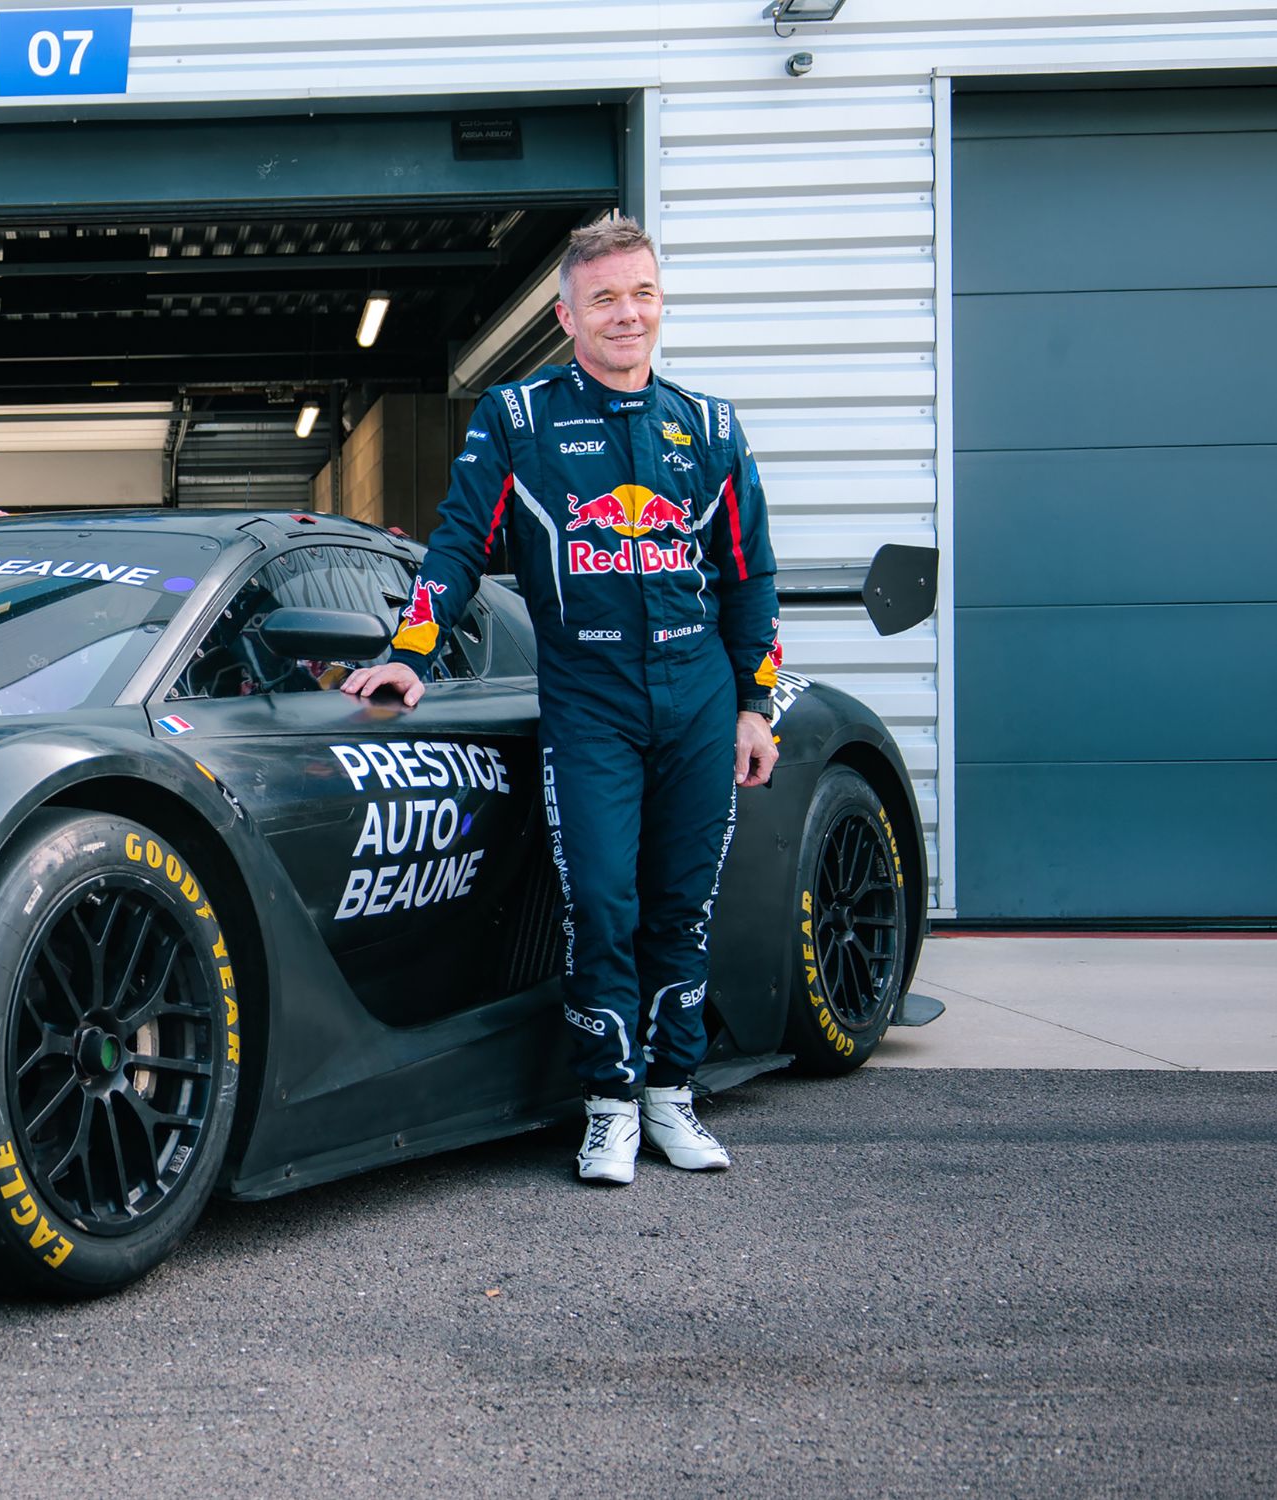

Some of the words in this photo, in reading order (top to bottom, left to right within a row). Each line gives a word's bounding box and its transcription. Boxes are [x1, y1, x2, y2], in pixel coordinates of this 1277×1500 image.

[28, 30, 93, 76] 07
[501, 388, 525, 430] sparco
[554, 419, 583, 427] RICHARD
[560, 440, 606, 454] SADEV
[568, 539, 634, 575] Red
[578, 630, 621, 641] sparco
[668, 627, 692, 639] S.LOEB
[329, 741, 510, 794] PRESTIGE
[352, 798, 458, 857] AUTO
[879, 806, 904, 889] EAGLE
[334, 849, 484, 920] BEAUNE
[125, 832, 240, 1065] GOODYEAR
[802, 890, 855, 1057] GOODYEAR
